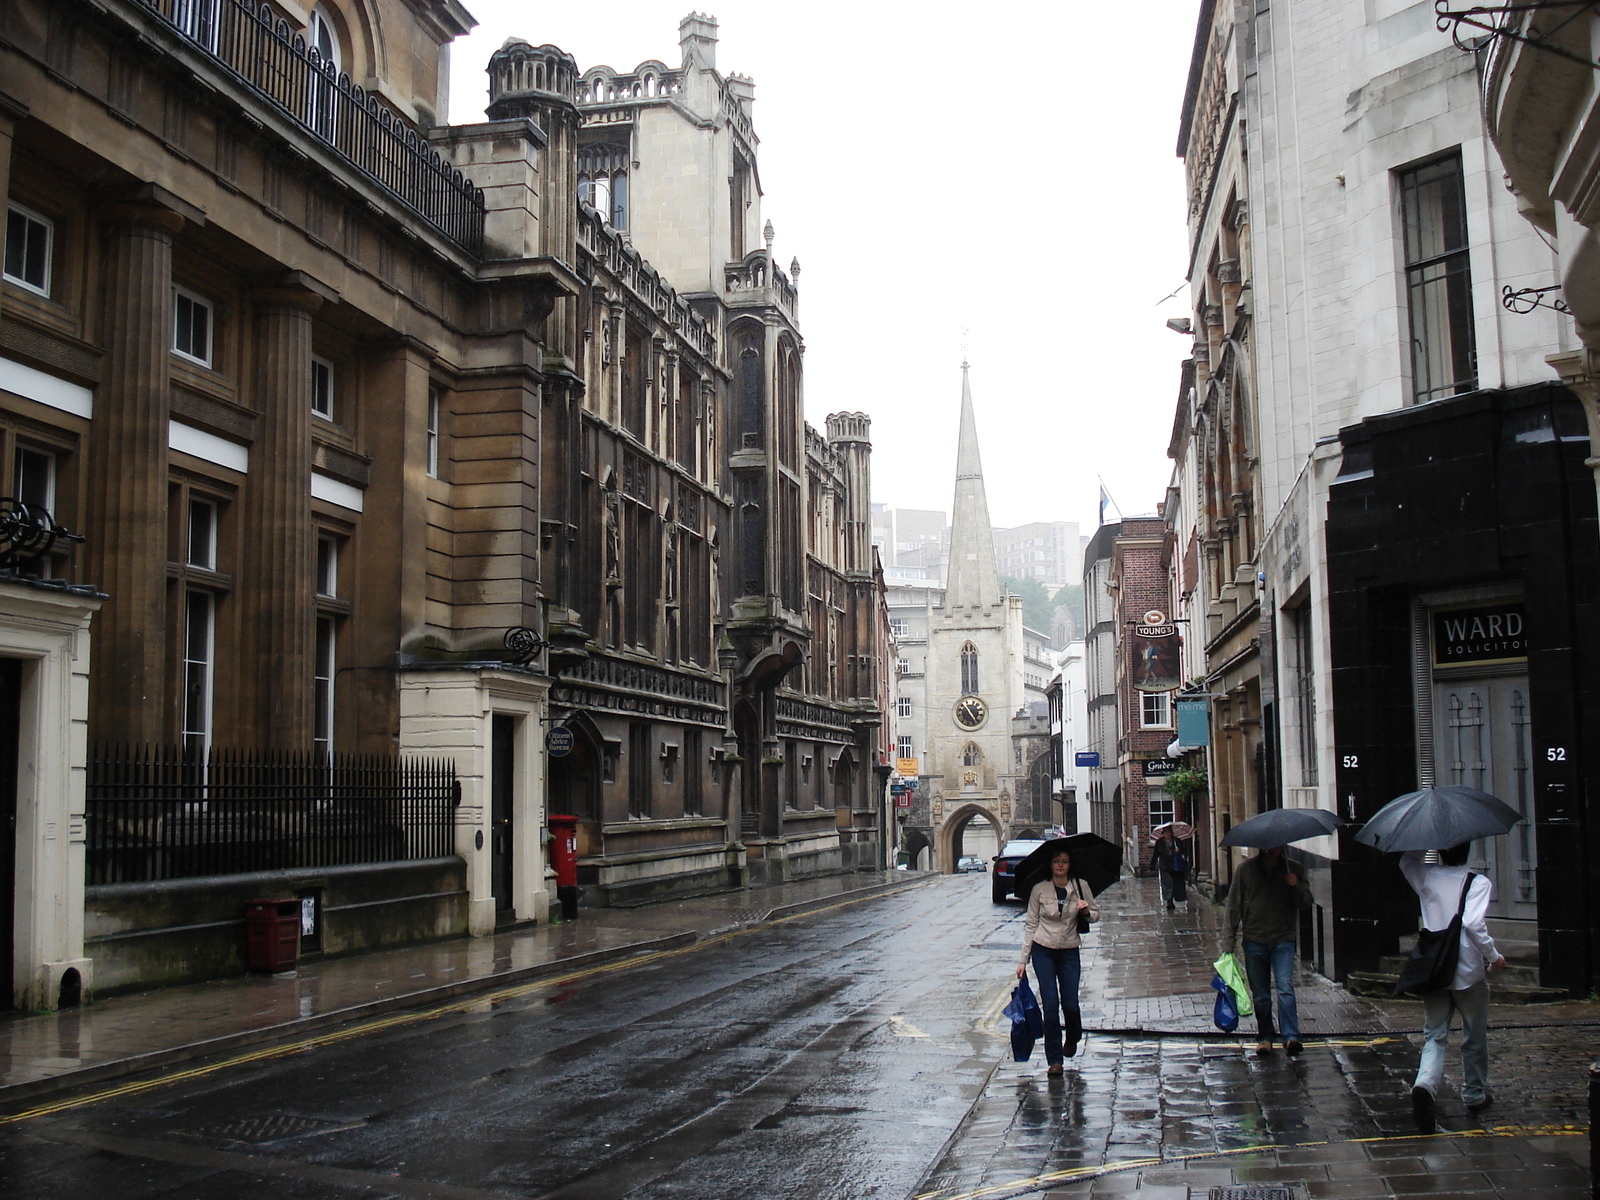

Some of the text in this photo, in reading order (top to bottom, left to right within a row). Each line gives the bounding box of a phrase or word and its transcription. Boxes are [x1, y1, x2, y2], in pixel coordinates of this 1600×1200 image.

[1138, 626, 1172, 635] YOUNG'S
[1443, 612, 1523, 642] WARD
[1547, 747, 1566, 761] 52
[1343, 755, 1358, 768] 52
